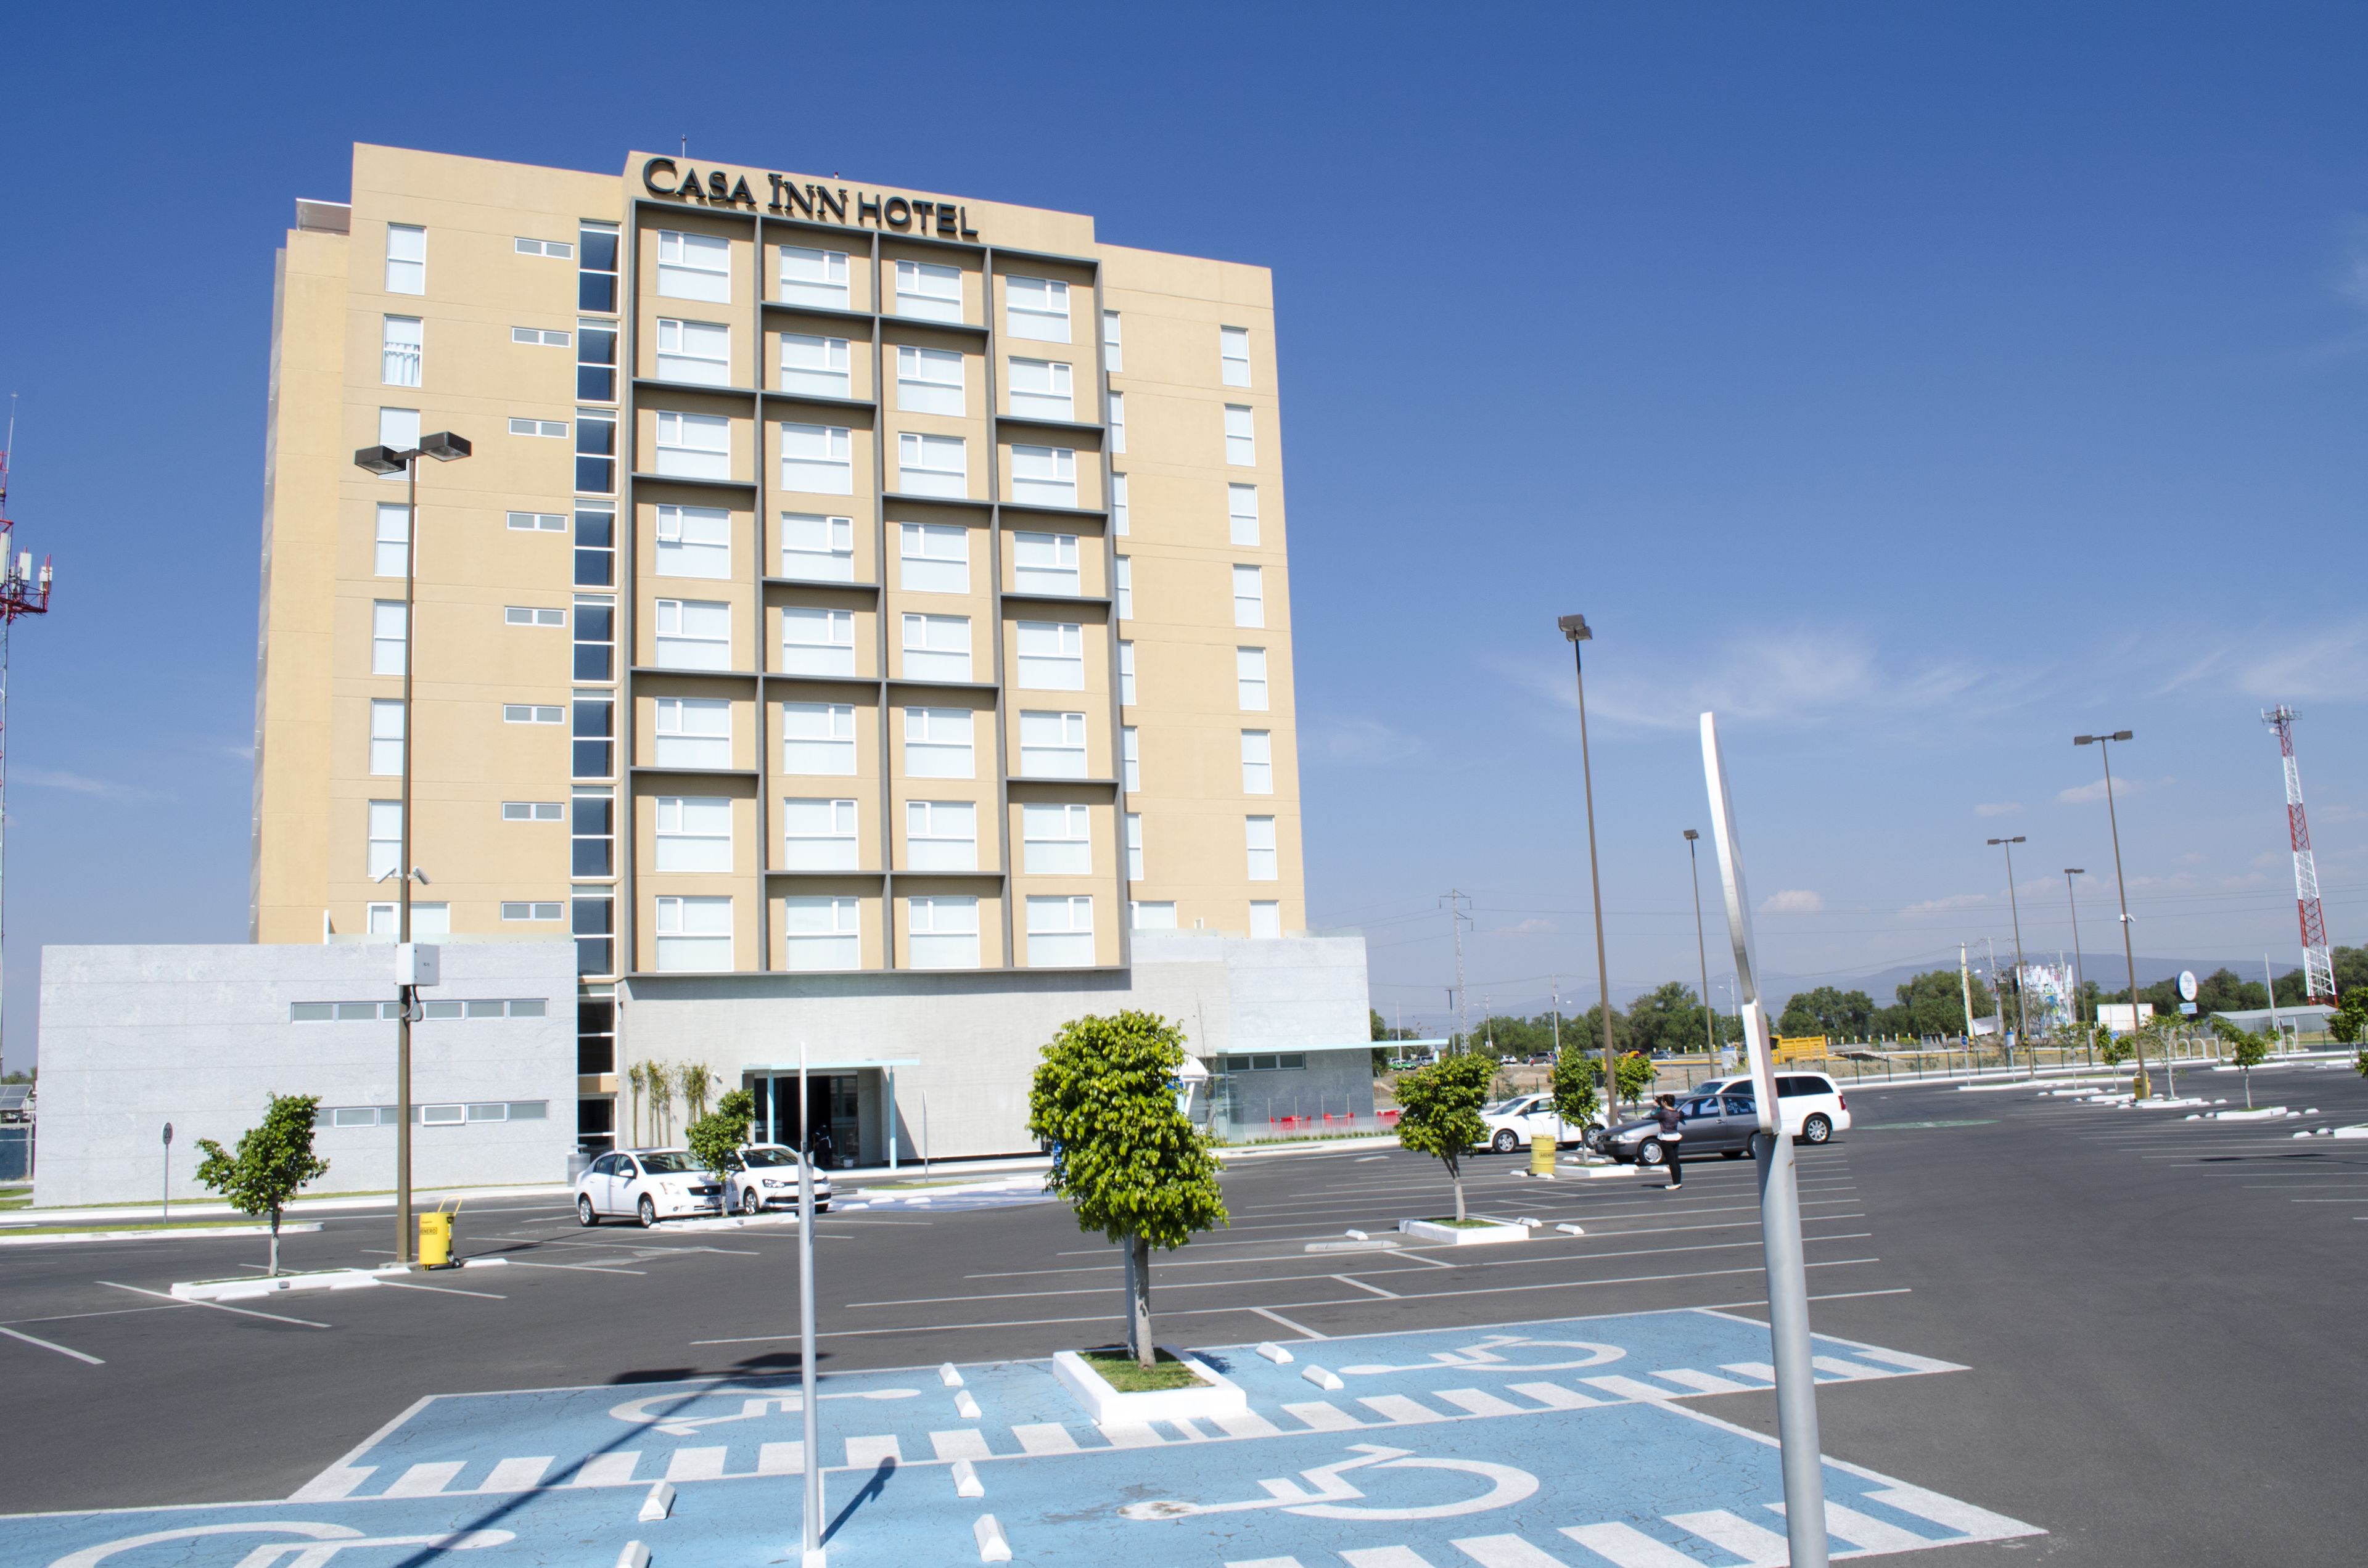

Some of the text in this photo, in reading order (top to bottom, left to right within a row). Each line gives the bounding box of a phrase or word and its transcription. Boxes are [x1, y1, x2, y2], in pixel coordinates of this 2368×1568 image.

[643, 157, 978, 236] CASA INN HOTEL
[165, 1128, 171, 1139] 20
